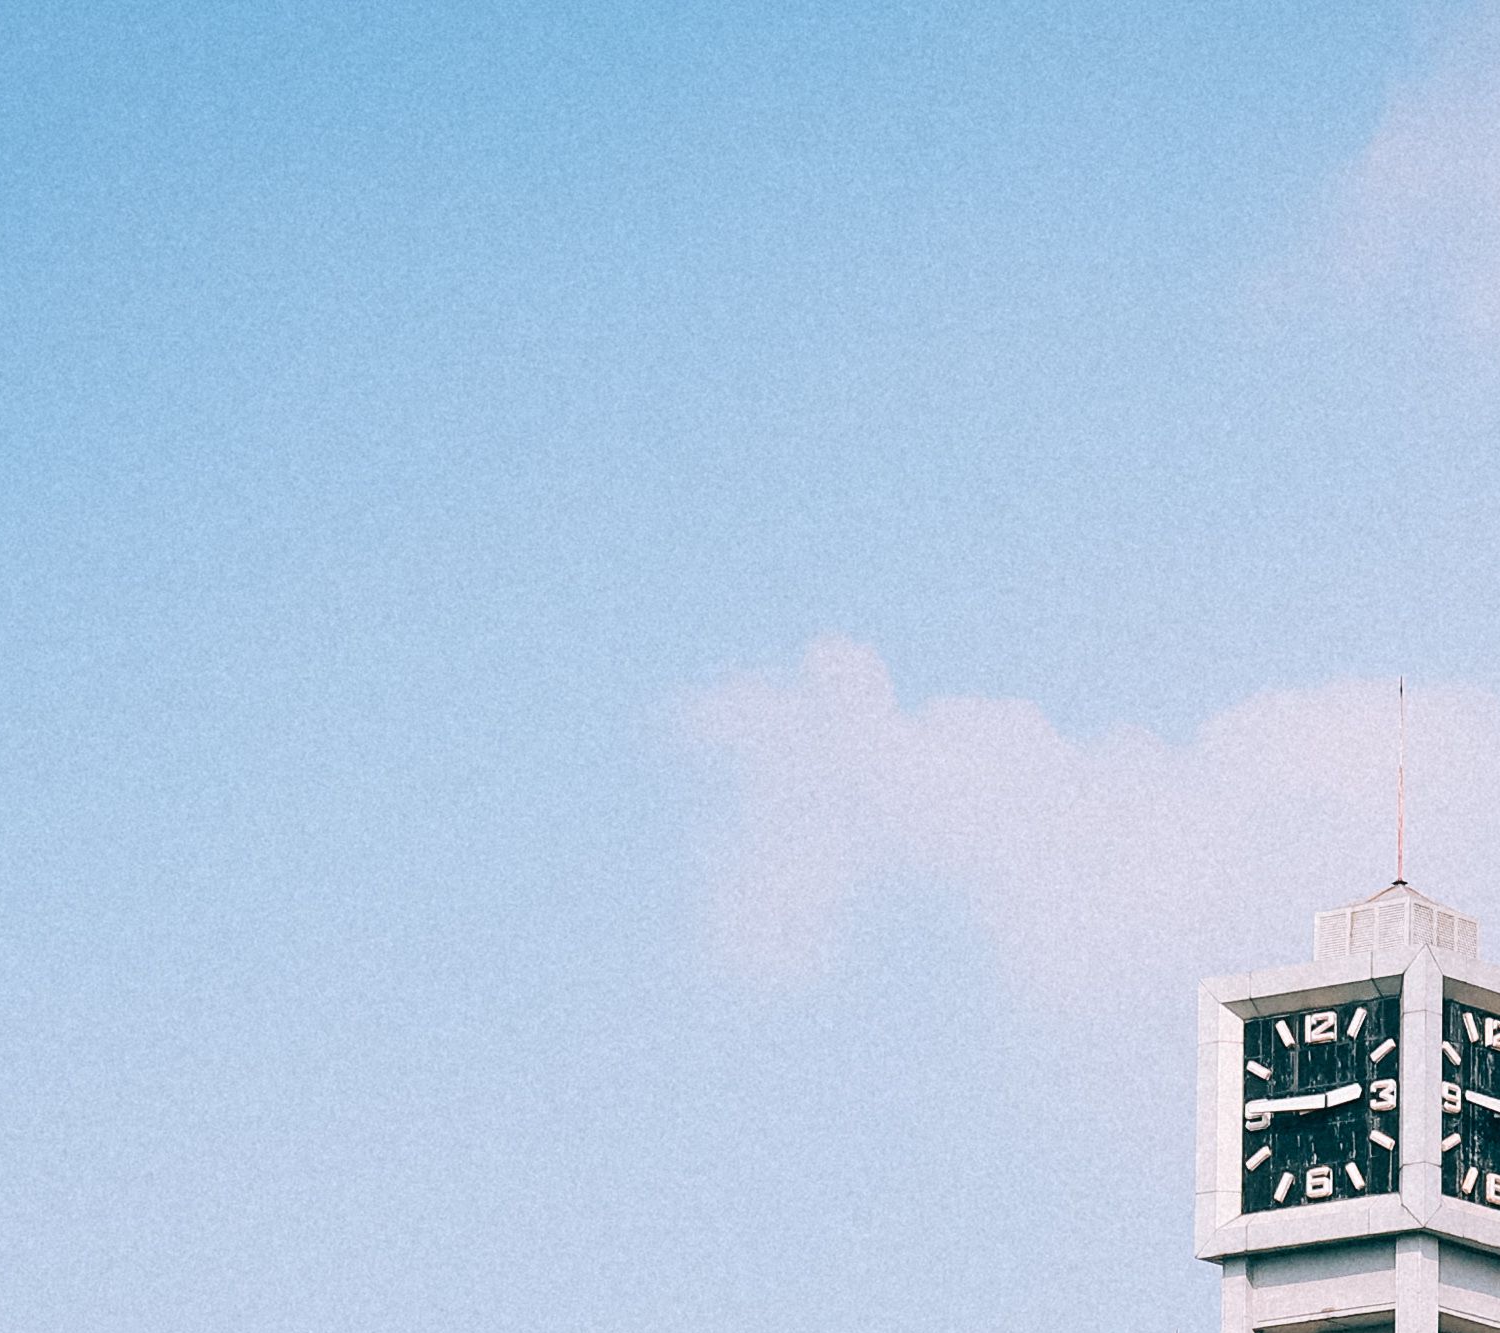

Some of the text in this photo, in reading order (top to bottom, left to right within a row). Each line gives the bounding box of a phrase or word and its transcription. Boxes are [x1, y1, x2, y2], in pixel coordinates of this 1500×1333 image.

[1304, 1010, 1337, 1044] 12
[1369, 1078, 1397, 1111] 3
[1442, 1080, 1462, 1114] 9
[1305, 1165, 1334, 1199] 6
